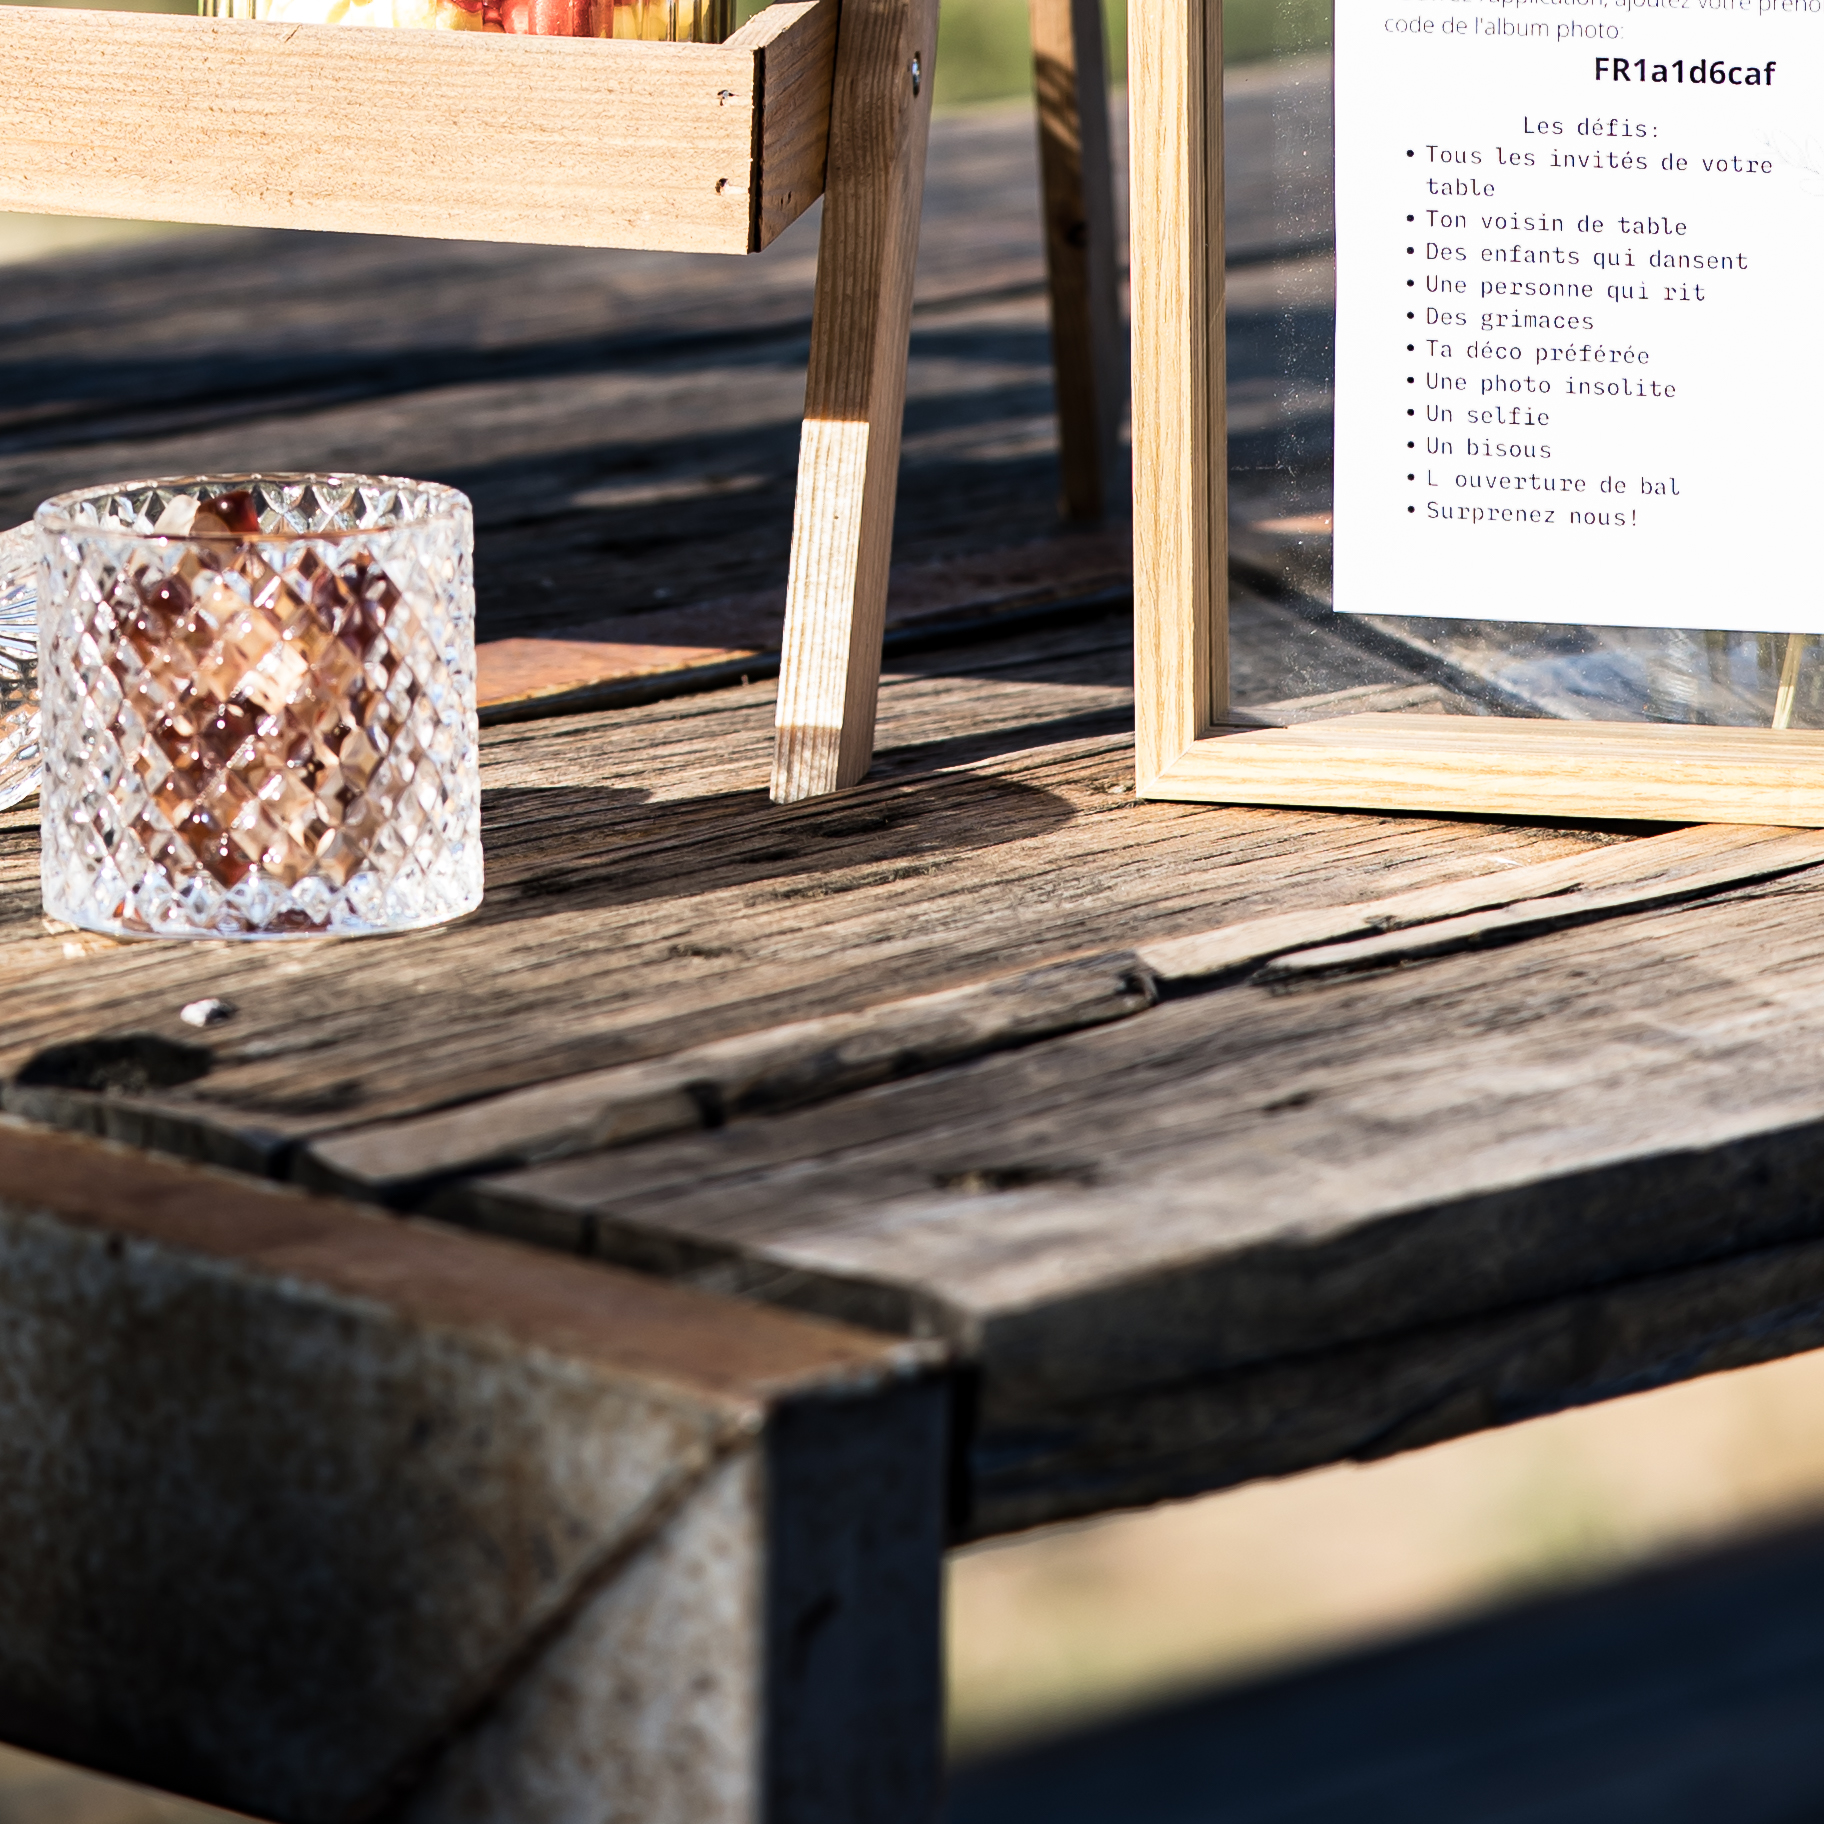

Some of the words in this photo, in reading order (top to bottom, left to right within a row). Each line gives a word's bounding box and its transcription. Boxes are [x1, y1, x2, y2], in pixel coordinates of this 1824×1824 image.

[1384, 15, 1435, 34] code
[1441, 16, 1468, 35] de
[1475, 16, 1549, 37] l'album
[1595, 56, 1777, 87] FR1a1d6caf
[1524, 115, 1564, 135] Les
[1577, 117, 1658, 138] défis:
[1425, 144, 1482, 165] Tous
[1495, 146, 1536, 167] les
[1549, 148, 1648, 170] invités
[1661, 152, 1688, 171] de
[1701, 155, 1773, 174] votre
[1426, 177, 1495, 197] table
[1425, 209, 1466, 229] Ton
[1481, 211, 1563, 232] voisin
[1577, 214, 1604, 234] de
[1617, 216, 1687, 236] table
[1426, 241, 1467, 262] Des
[1481, 244, 1580, 265] enfants
[1593, 247, 1636, 270] qui
[1649, 249, 1748, 270] dansent
[1426, 274, 1467, 294] Une
[1481, 280, 1593, 299] personne
[1607, 280, 1649, 304] qui
[1663, 282, 1705, 302] rit
[1426, 306, 1467, 326] Des
[1480, 309, 1594, 332] grimaces
[1425, 339, 1452, 358] Ta
[1466, 340, 1522, 360] déco
[1536, 342, 1650, 366] préférée
[1426, 371, 1467, 391] Une
[1481, 373, 1551, 396] photo
[1565, 376, 1676, 398] insolite
[1426, 404, 1453, 423] Un
[1467, 405, 1550, 426] selfie
[1426, 436, 1453, 455] Un
[1467, 437, 1551, 459] bisous
[1455, 473, 1586, 493] ouverture
[1600, 475, 1626, 494] de
[1641, 476, 1680, 496] bal
[1427, 500, 1555, 525] Surprenez
[1570, 508, 1636, 527] nous!
